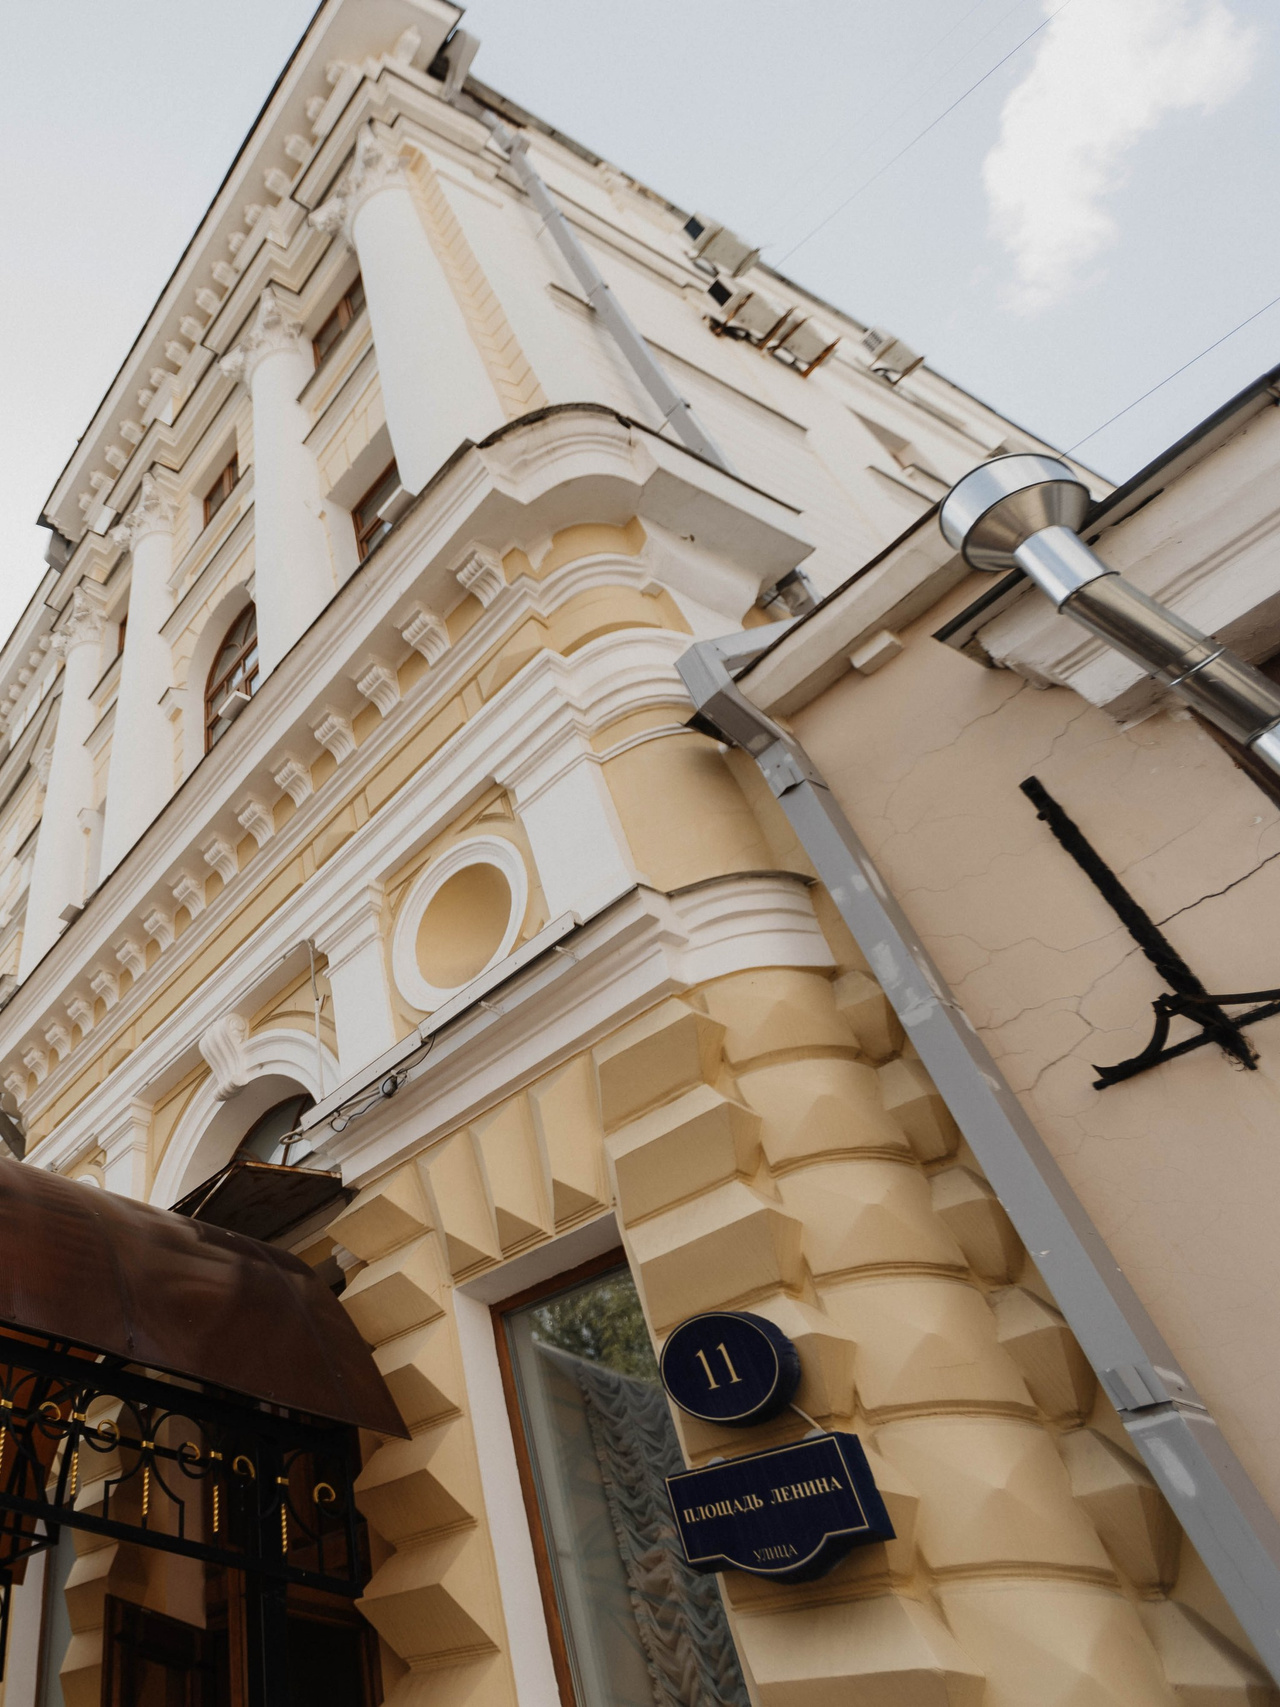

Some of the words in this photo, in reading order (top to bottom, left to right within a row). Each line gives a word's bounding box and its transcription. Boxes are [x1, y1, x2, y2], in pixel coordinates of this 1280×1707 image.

[695, 1342, 742, 1390] 11
[683, 1493, 764, 1524] ПЛОЩАДЬ
[770, 1475, 843, 1505] ЛЕНИНА
[753, 1543, 799, 1563] УЛИЦА
